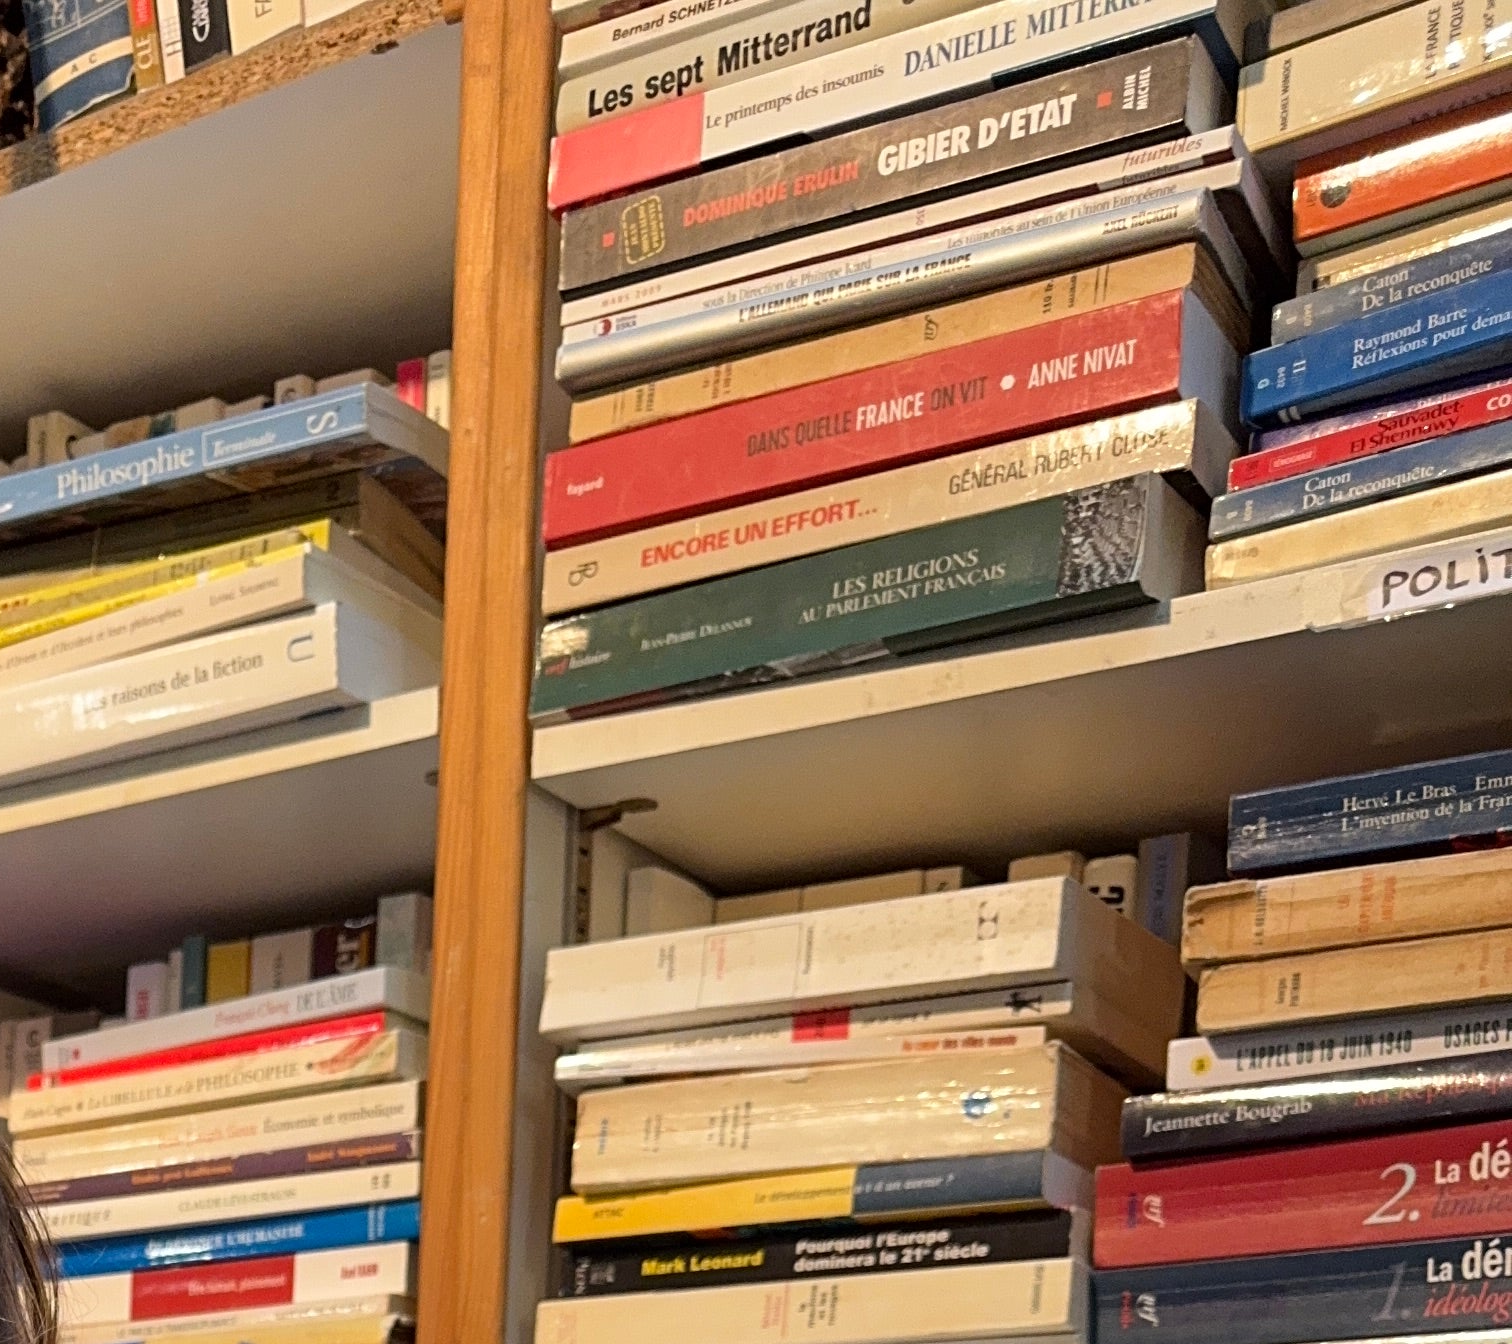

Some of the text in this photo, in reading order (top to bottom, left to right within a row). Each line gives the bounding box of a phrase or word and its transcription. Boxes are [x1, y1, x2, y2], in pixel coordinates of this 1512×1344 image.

[589, 0, 872, 118] Les sept Mitterrand
[706, 19, 1018, 130] Le printemps des insoumis DANIELLE
[683, 94, 1077, 227] DOMINIQUE ERULIN GIBIER D'ETAT
[1122, 136, 1203, 173] futuribles
[1361, 267, 1410, 295] Caton
[1361, 286, 1403, 313] De la
[1351, 325, 1467, 371] Réflexions pour
[1353, 305, 1468, 353] Raymond Barre
[855, 338, 1138, 433] FRANCE VIT ANNE NIVAT
[56, 440, 196, 500] Philosophie
[948, 456, 1028, 496] GÉNÉRAL
[1304, 471, 1351, 493] Caton
[640, 518, 769, 568] ENCORE UN
[798, 562, 1007, 625] AU PARLEMENT FRANÇAIS
[831, 549, 980, 599] LES RELIGIONS
[110, 651, 265, 711] raisons de la fiction
[1421, 782, 1458, 801] Bras
[1434, 798, 1474, 818] de la
[1338, 1034, 1374, 1061] JUIN
[195, 1061, 300, 1094] PHILOSOPHE
[262, 1100, 406, 1135] Économie et symbolique
[1143, 1097, 1314, 1137] Jeannette Bougrab
[1434, 1159, 1462, 1185] La
[640, 1234, 872, 1277] Mark Leonard Pourquoi
[792, 1240, 990, 1274] dominera le siècle
[1426, 1257, 1454, 1284] La
